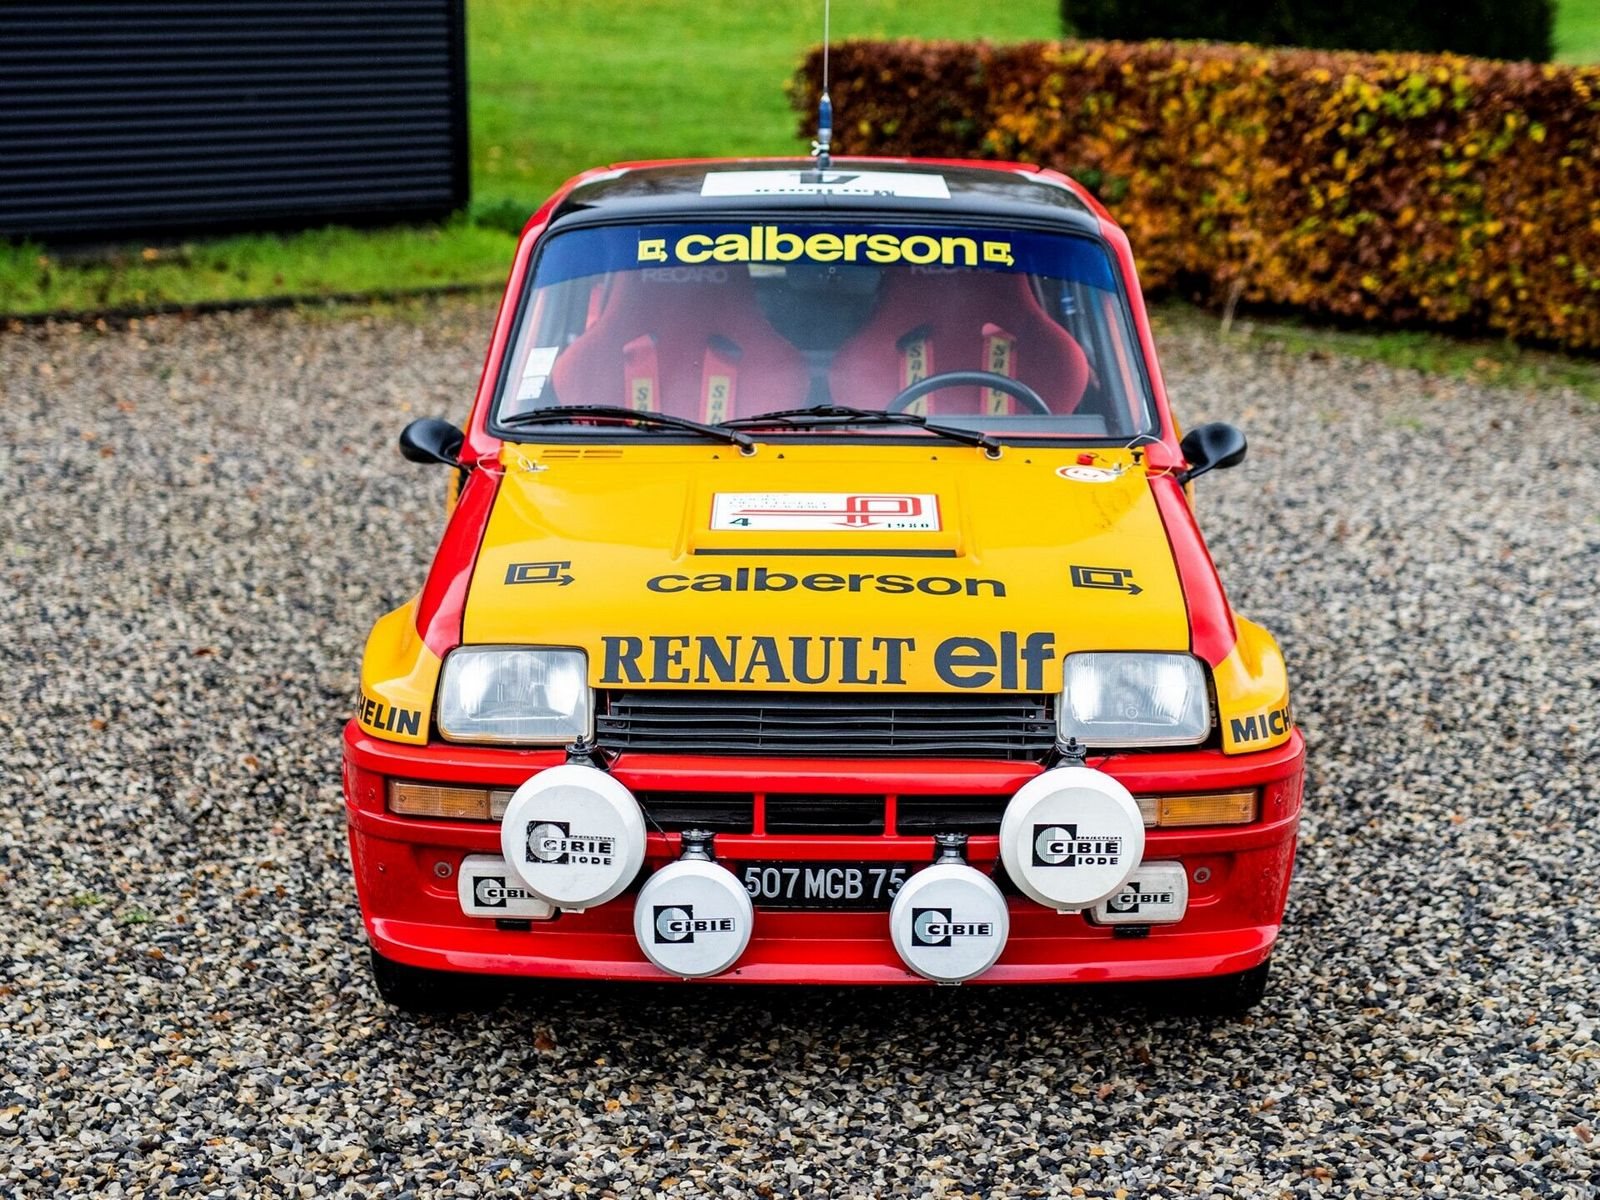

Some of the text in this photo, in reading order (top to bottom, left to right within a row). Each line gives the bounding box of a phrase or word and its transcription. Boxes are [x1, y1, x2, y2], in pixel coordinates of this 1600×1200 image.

[675, 226, 978, 266] calberson
[646, 567, 1007, 597] calberson
[599, 631, 1055, 691] RENAULT elf
[571, 856, 612, 865] IODE
[1078, 857, 1119, 865] IODE
[744, 867, 907, 899] 507 MGB 75
